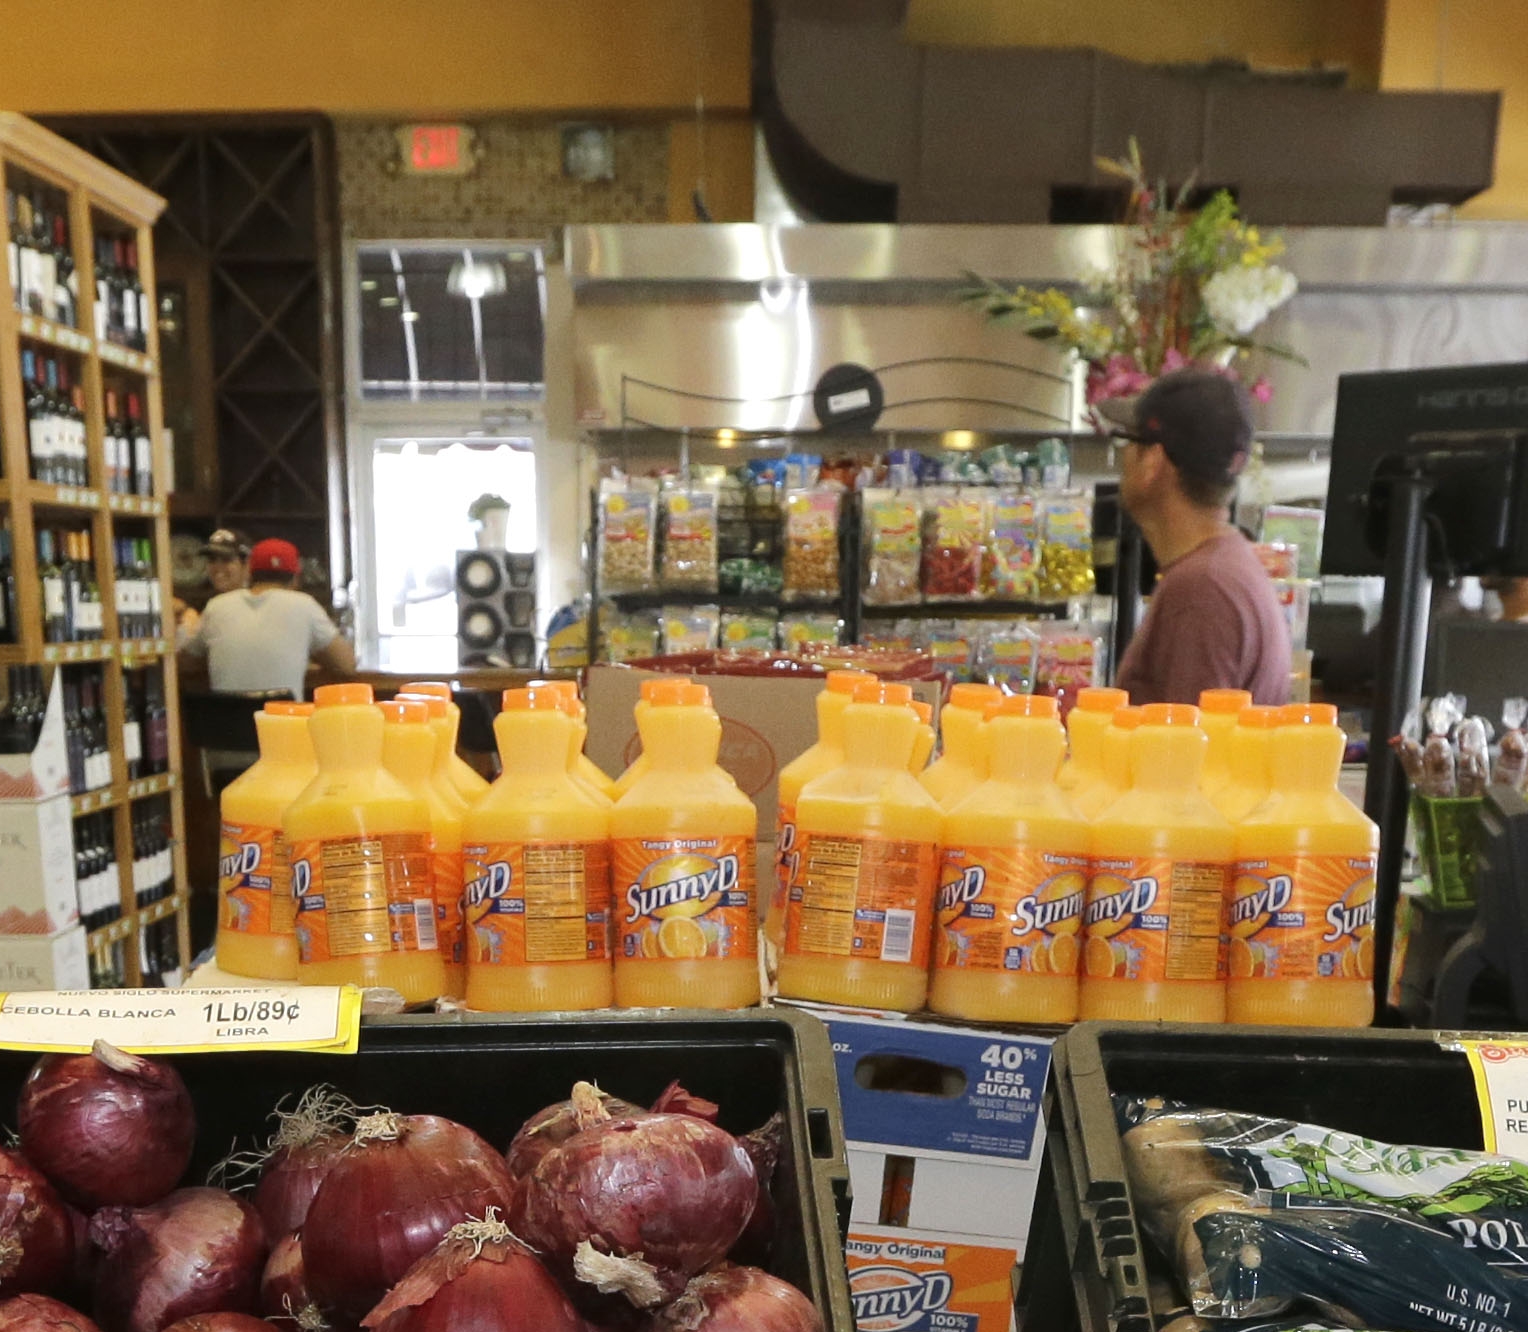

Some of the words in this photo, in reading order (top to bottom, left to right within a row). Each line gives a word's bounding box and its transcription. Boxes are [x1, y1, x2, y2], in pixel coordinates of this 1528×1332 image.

[641, 841, 671, 851] Tangy
[674, 839, 717, 849] Original
[626, 854, 739, 924] SunnyD
[1086, 876, 1159, 926] nnyD
[1229, 874, 1293, 927] nnyD
[1011, 890, 1086, 936] Sunn
[1141, 915, 1168, 924] 100%
[1277, 913, 1303, 922] 100%
[1, 1006, 91, 1017] CEBOLLA
[98, 1008, 177, 1019] BLANCA
[203, 999, 300, 1025] 1Lb/89¢
[216, 1027, 269, 1037] LIBRA
[980, 1044, 1038, 1070] 40%
[985, 1070, 1025, 1086] LESS
[976, 1083, 1032, 1100] SUGAR
[846, 1241, 883, 1254] angy
[887, 1243, 946, 1259] Original
[852, 1273, 953, 1318] nnyD
[1446, 1283, 1471, 1308] U.S.
[1475, 1292, 1498, 1315] NO.
[1503, 1302, 1512, 1318] 1
[930, 1314, 969, 1328] 100%
[1436, 1310, 1458, 1326] WT
[1457, 1317, 1468, 1331] 5
